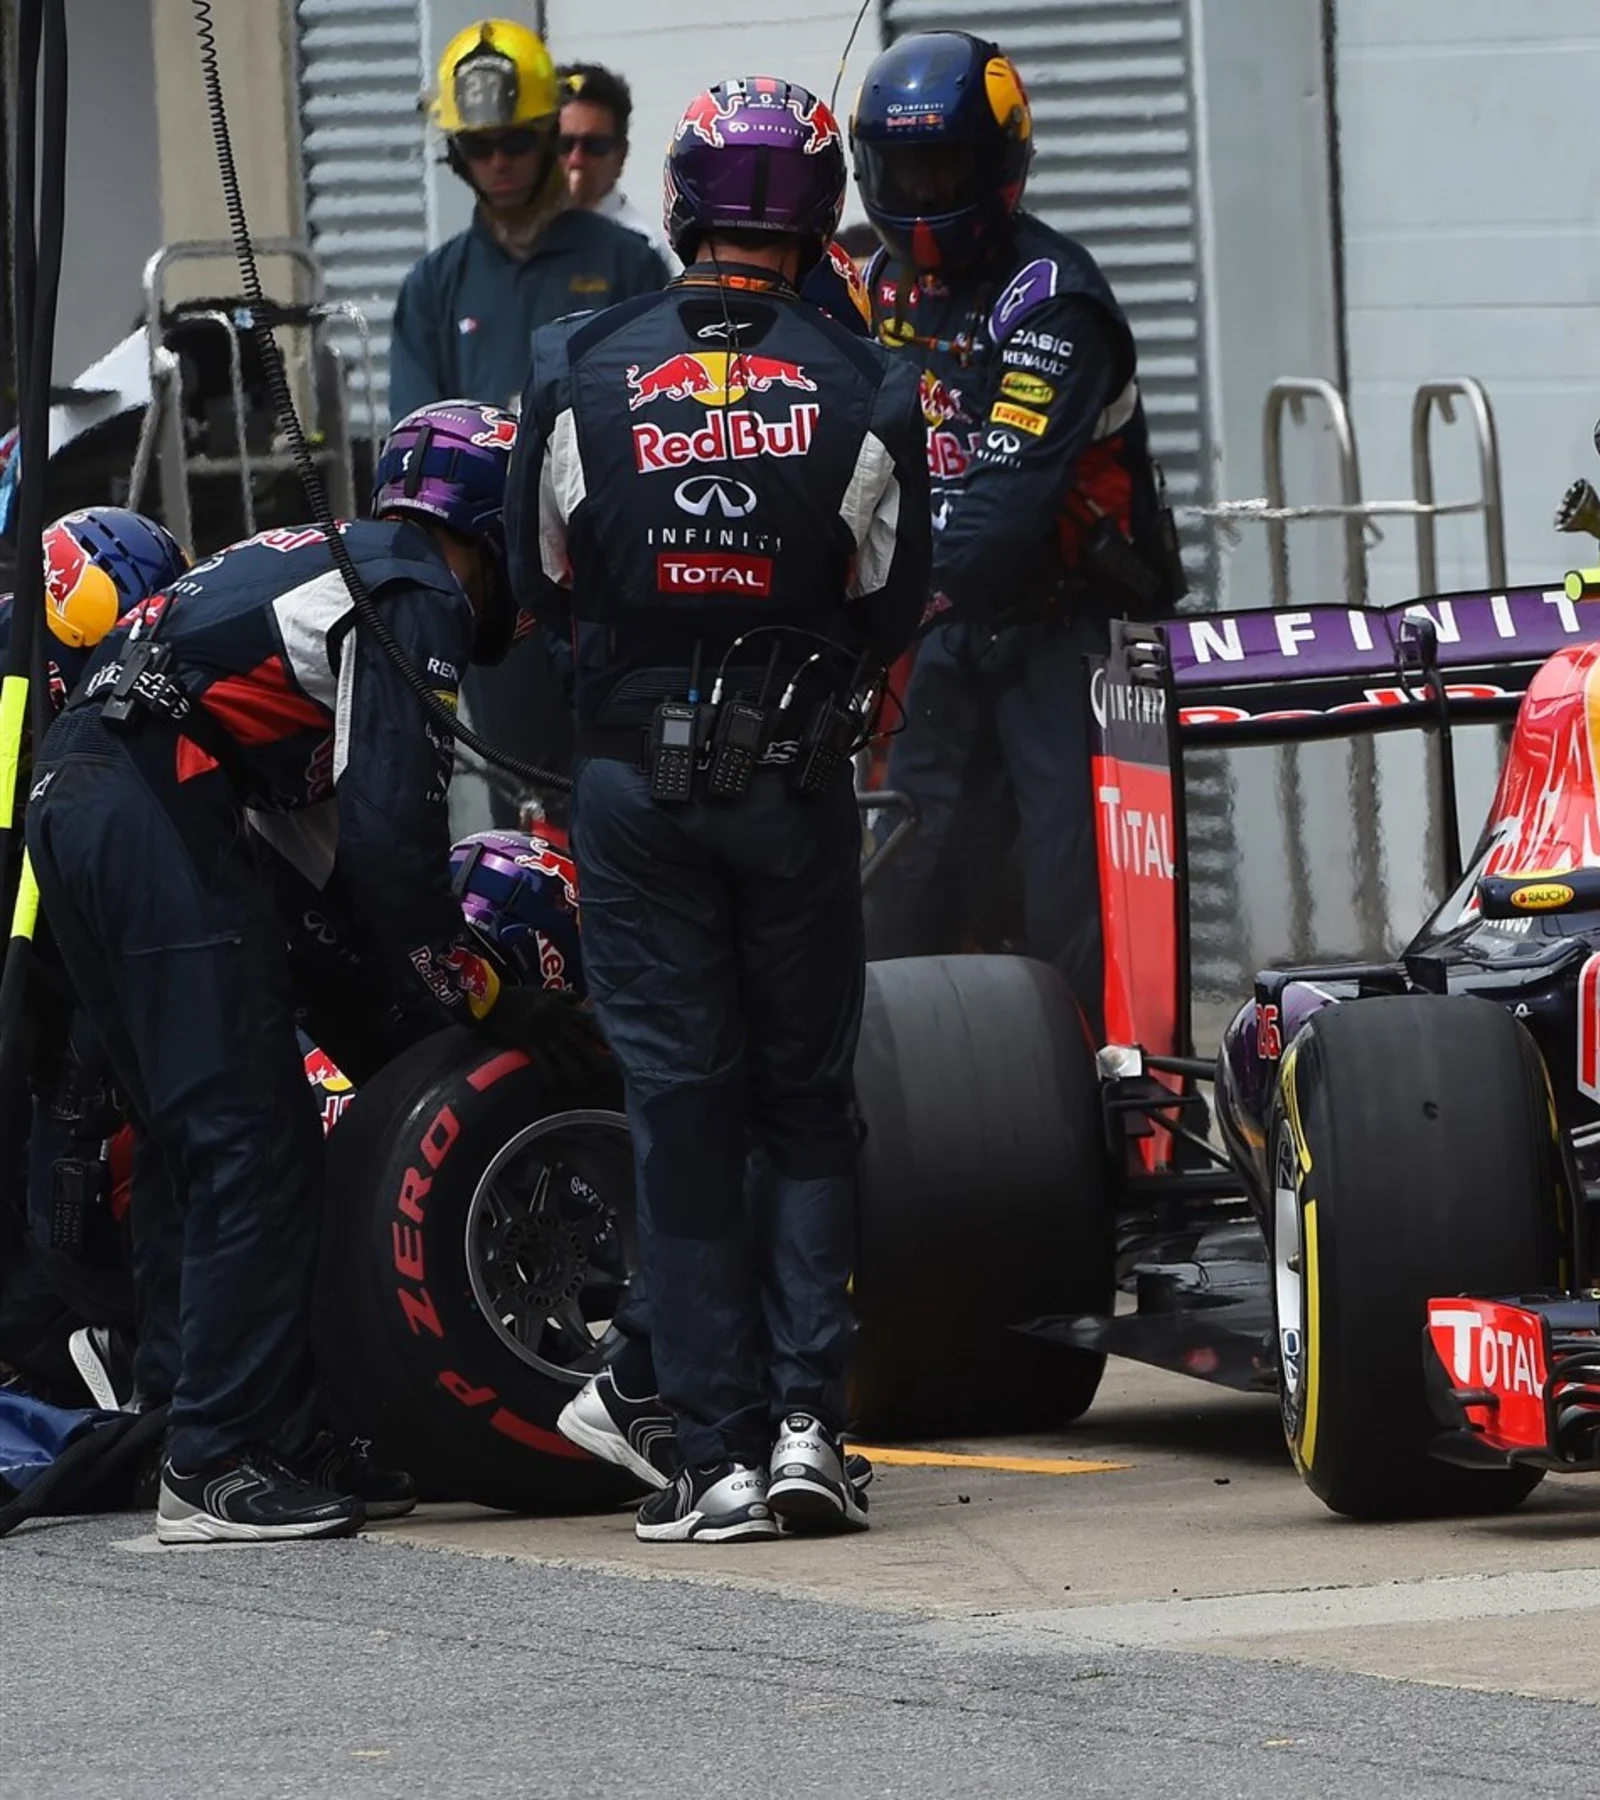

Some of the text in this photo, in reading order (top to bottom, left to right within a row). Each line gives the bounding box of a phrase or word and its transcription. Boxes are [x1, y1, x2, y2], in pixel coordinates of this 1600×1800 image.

[663, 562, 764, 588] TOTAL
[1100, 785, 1176, 880] TOTAL
[1528, 889, 1566, 902] RAUCH
[392, 1103, 460, 1339] ZERO
[1430, 1309, 1544, 1400] TOTAL
[777, 1440, 821, 1455] GEOX
